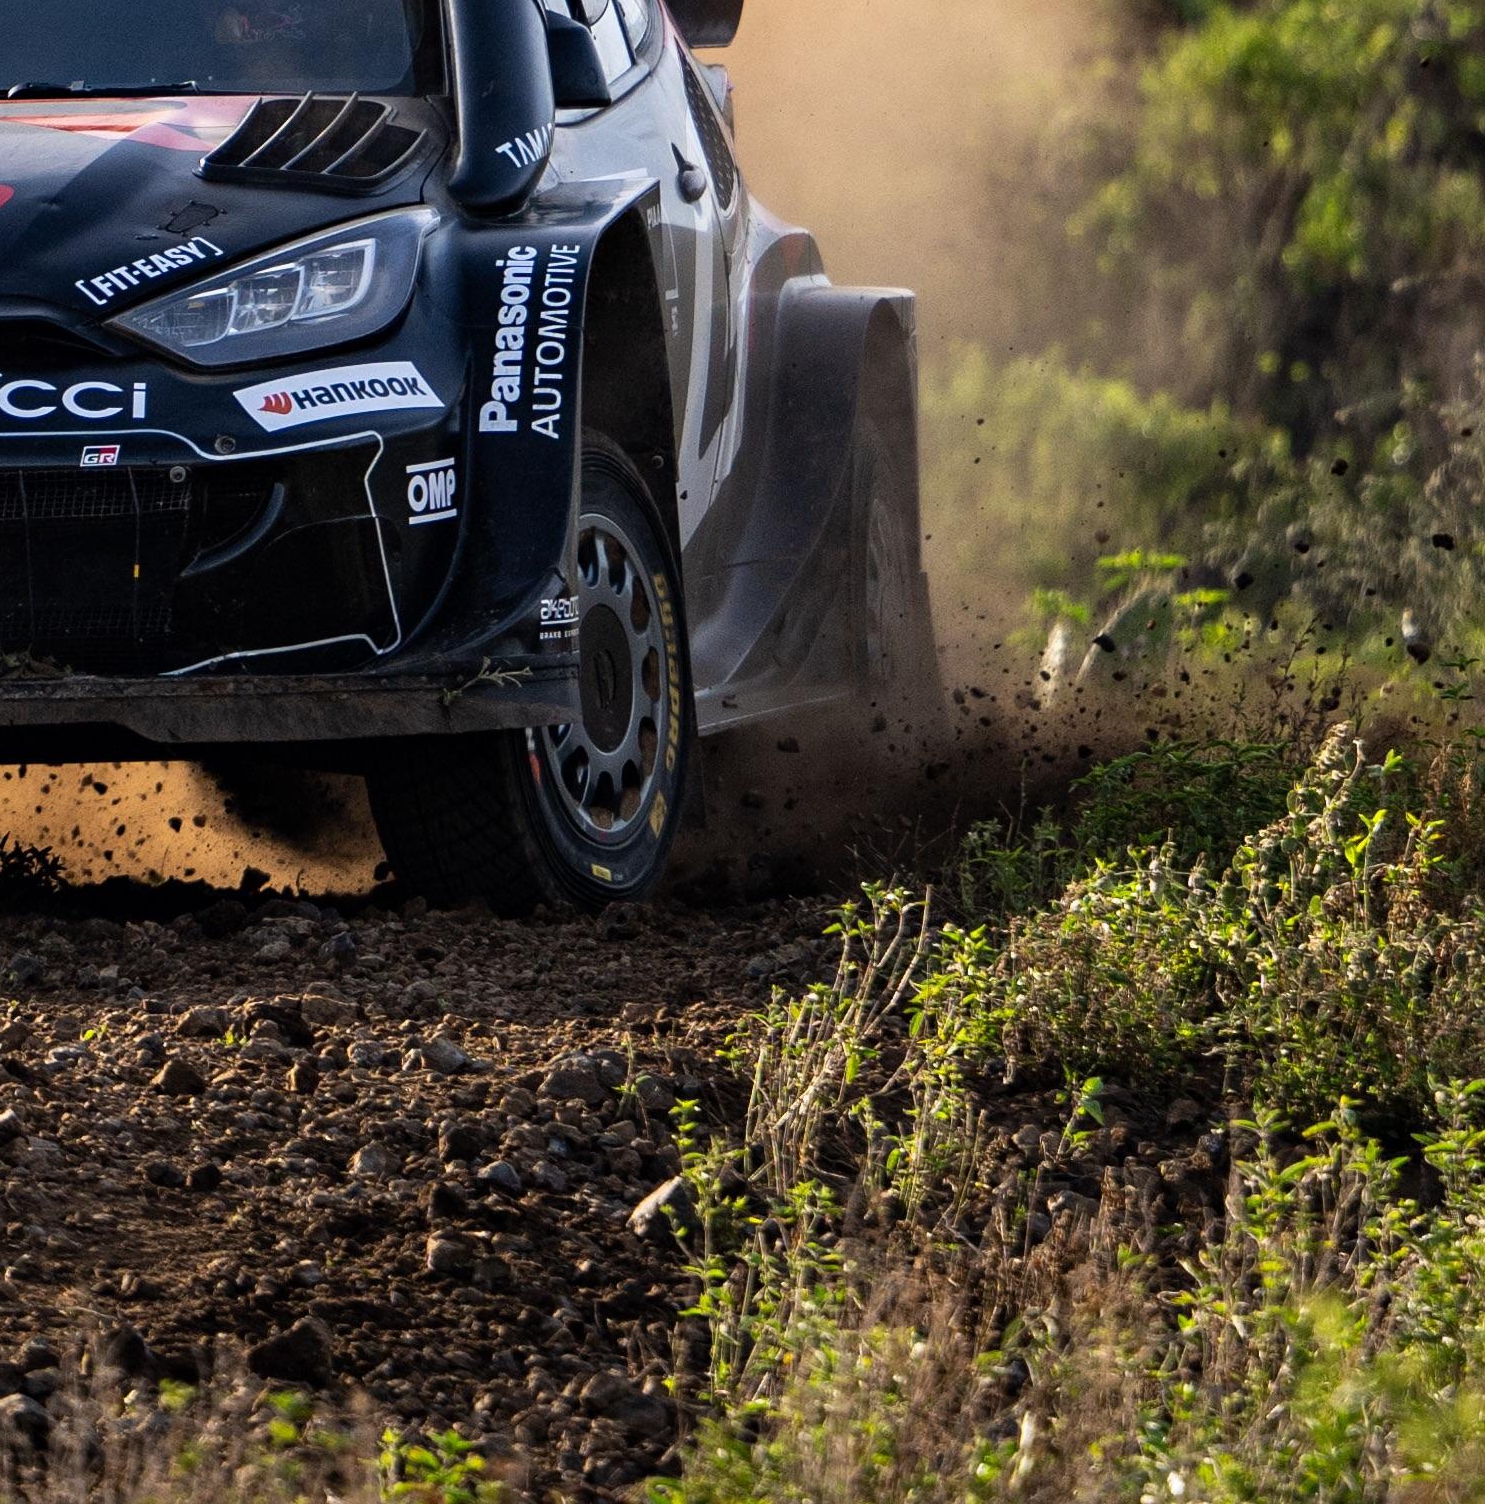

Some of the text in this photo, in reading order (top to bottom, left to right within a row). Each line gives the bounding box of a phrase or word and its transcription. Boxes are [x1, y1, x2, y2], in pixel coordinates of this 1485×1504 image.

[479, 245, 538, 432] Panasonic
[531, 244, 581, 440] AUTOMOTIVE
[407, 468, 456, 512] OMP
